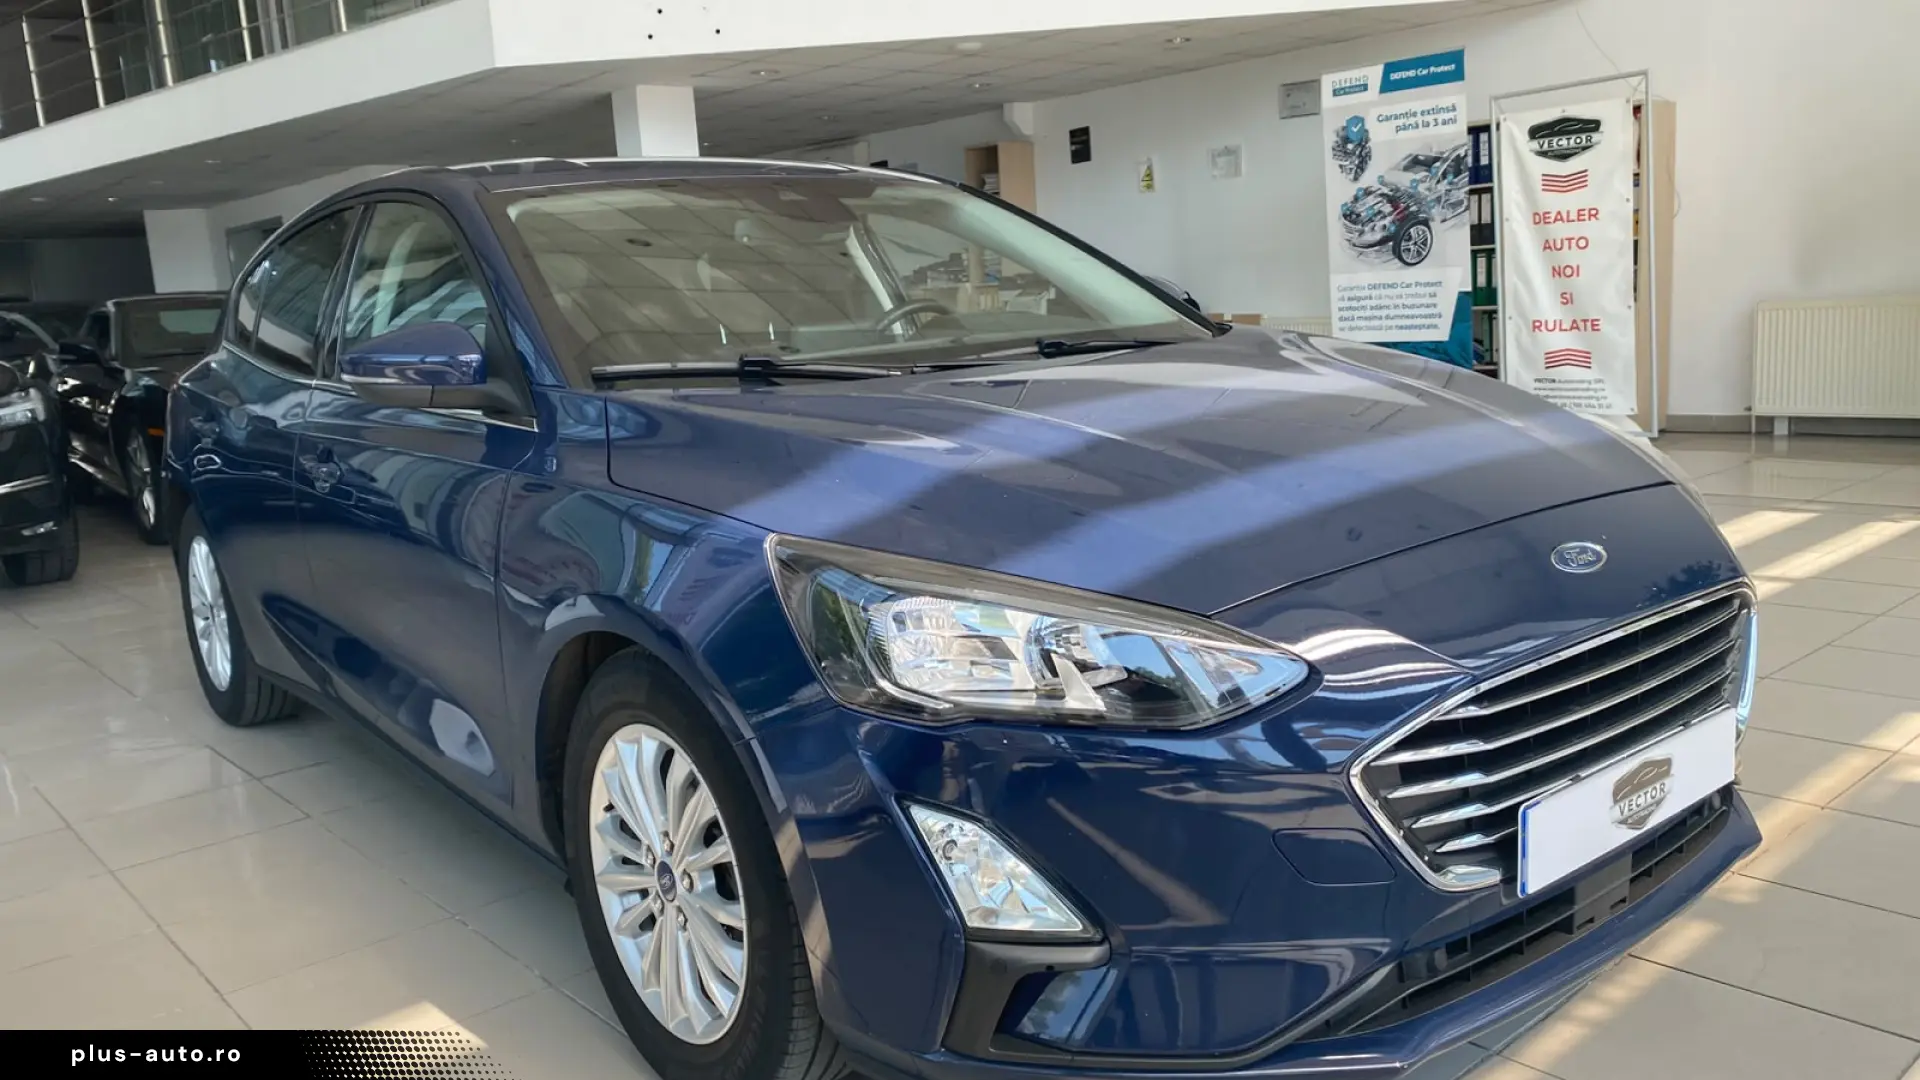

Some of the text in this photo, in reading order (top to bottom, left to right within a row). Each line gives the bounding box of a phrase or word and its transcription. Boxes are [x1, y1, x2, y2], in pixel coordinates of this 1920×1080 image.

[1390, 64, 1456, 80] DEFEND Car Protect
[1332, 75, 1369, 88] DEFEND
[1377, 103, 1457, 122] Garanție extinsă
[1396, 115, 1457, 134] până la 3 ani
[1538, 134, 1593, 149] VECTOR
[1532, 208, 1600, 225] DEALER
[1542, 236, 1590, 252] AUTO
[1552, 264, 1580, 278] NOI
[1367, 282, 1398, 290] DEFEND
[1560, 292, 1574, 306] SI
[1532, 318, 1601, 332] RULATE
[1563, 548, 1597, 567] Ford
[1618, 782, 1666, 816] VECTOR
